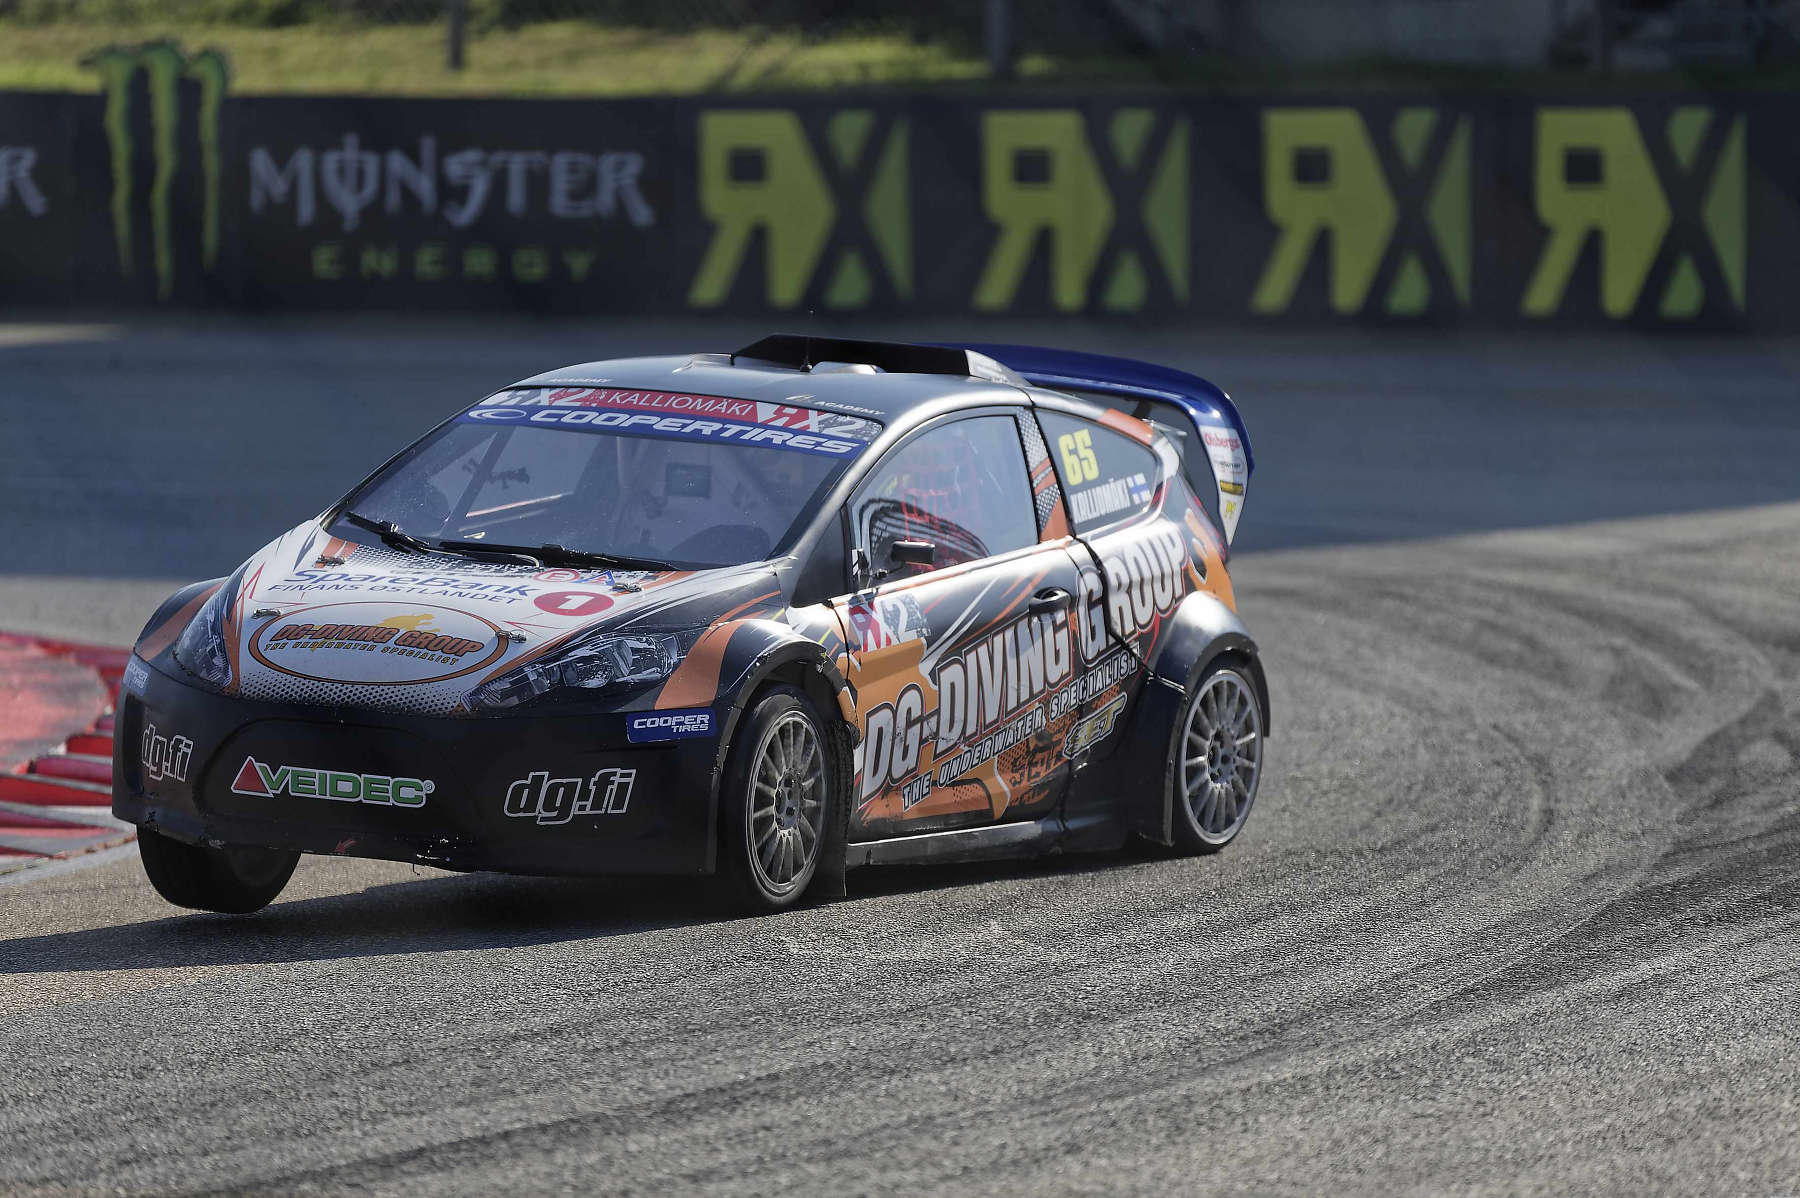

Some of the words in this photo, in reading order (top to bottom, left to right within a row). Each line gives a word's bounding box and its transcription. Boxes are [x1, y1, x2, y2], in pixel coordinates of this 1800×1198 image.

[247, 133, 656, 228] MONSTER
[311, 244, 597, 282] ENERGY
[606, 391, 755, 417] KALLIOMÄKI
[1058, 428, 1100, 486] 65
[267, 584, 364, 592] FINANS
[368, 585, 524, 604] ØSTLANDET
[283, 569, 542, 597] SpareBank
[557, 594, 595, 610] 1
[264, 643, 289, 652] THE
[269, 623, 401, 644] DG-DIVING
[394, 630, 485, 658] GROUP
[858, 606, 1074, 809] DG-DIVING
[1076, 528, 1187, 666] GROUP
[633, 714, 710, 729] COOPER
[671, 723, 709, 733] TIRES
[141, 723, 194, 783] dg.fi
[902, 768, 934, 812] THE
[938, 702, 1047, 789] UNDERWATER
[503, 767, 637, 825] dg.fi
